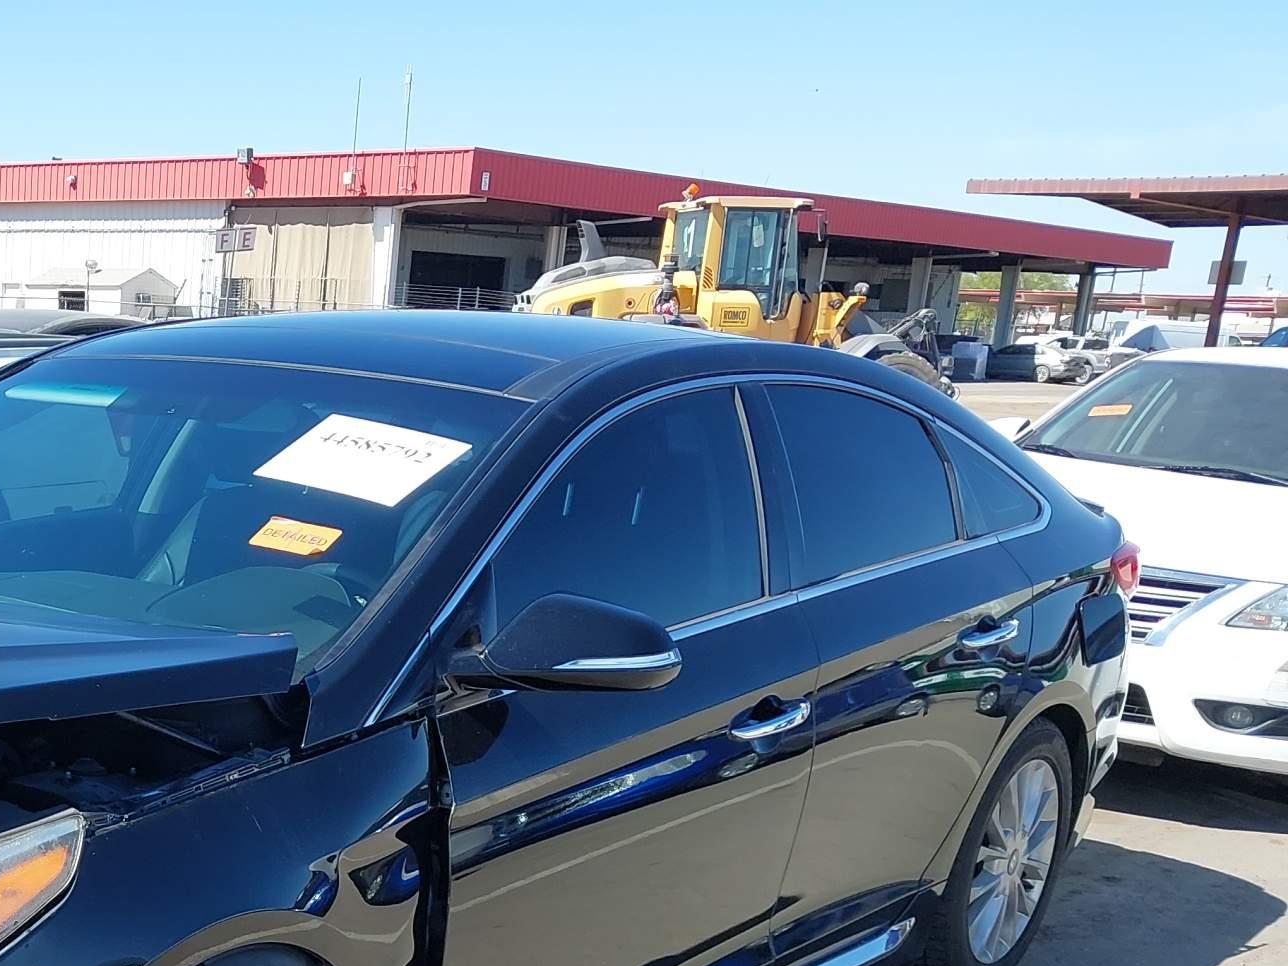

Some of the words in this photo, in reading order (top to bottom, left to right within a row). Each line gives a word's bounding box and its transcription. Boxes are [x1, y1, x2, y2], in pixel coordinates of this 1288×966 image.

[220, 233, 229, 250] F
[242, 231, 252, 248] E
[723, 310, 747, 321] ROMCO
[262, 527, 328, 546] DETAILED
